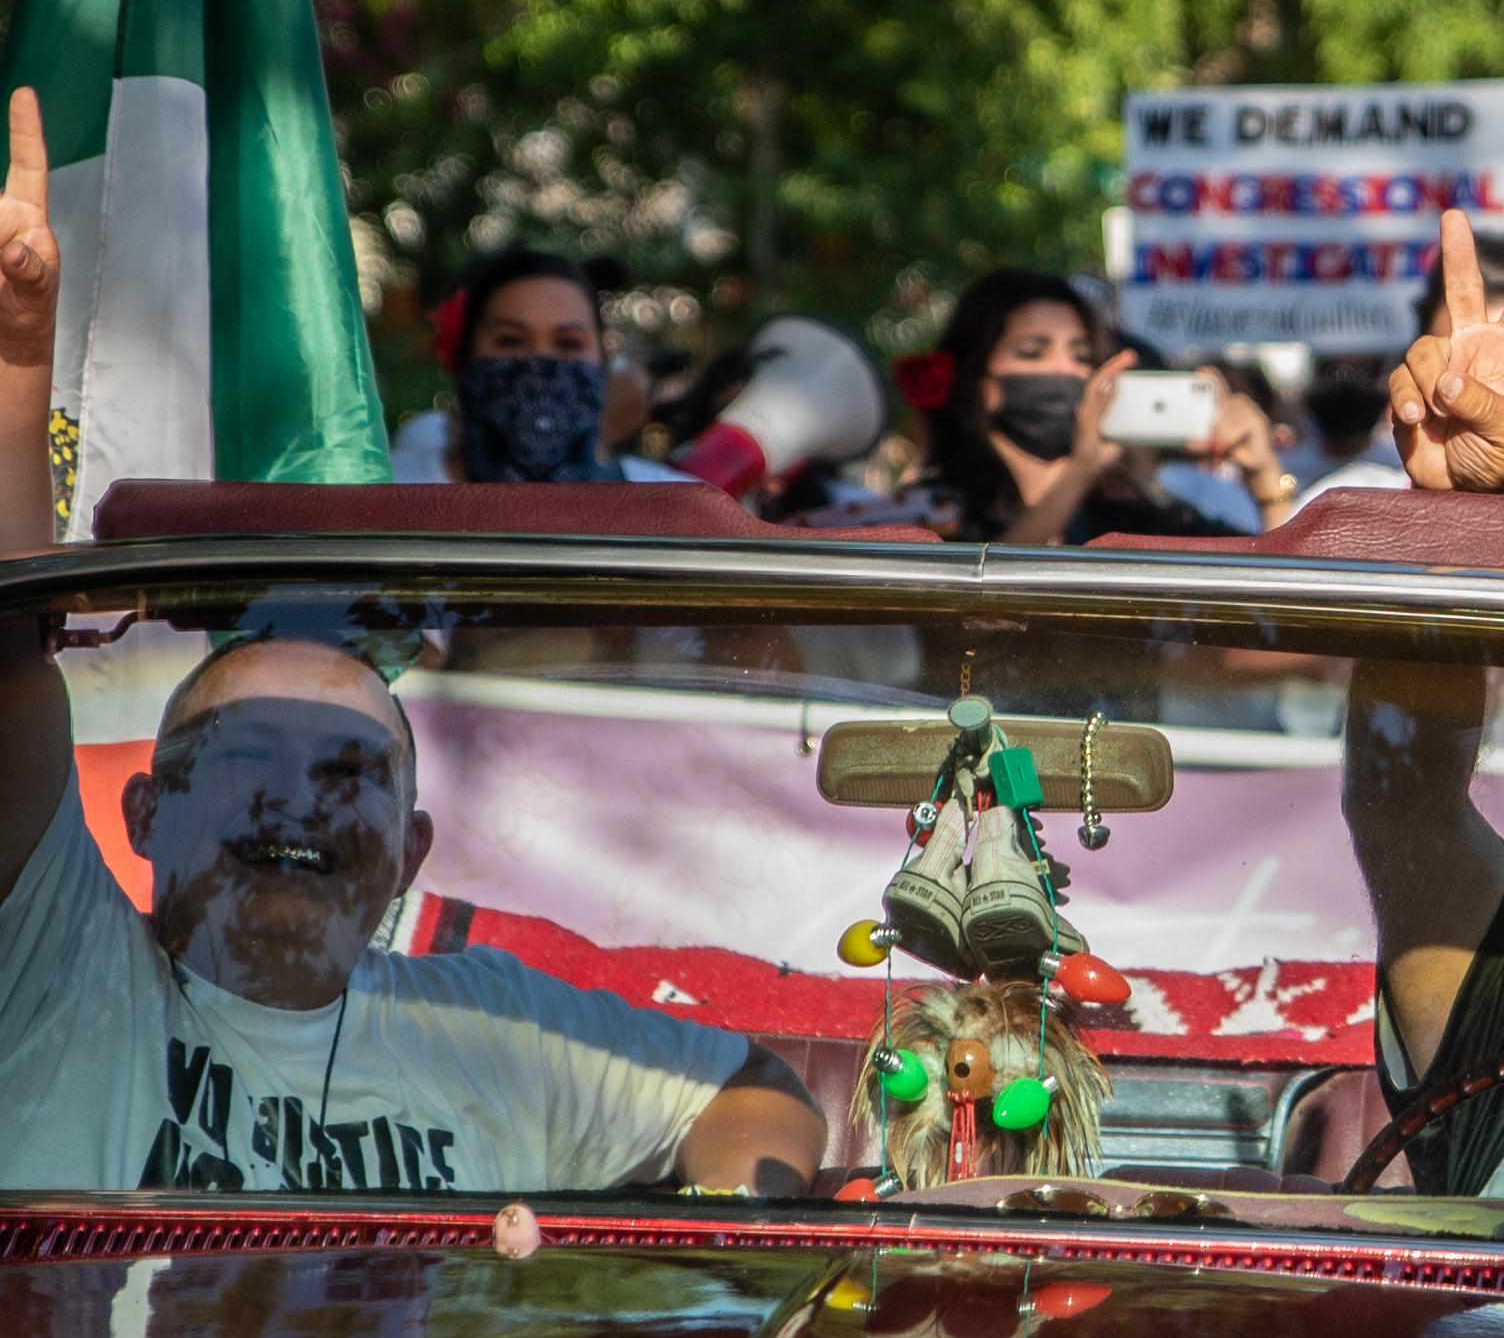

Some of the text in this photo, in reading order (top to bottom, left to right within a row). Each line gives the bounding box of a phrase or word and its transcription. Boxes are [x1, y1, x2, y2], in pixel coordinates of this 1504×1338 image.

[1139, 102, 1473, 145] WE DEMAND
[1128, 171, 1504, 213] CONGRESSIONAL
